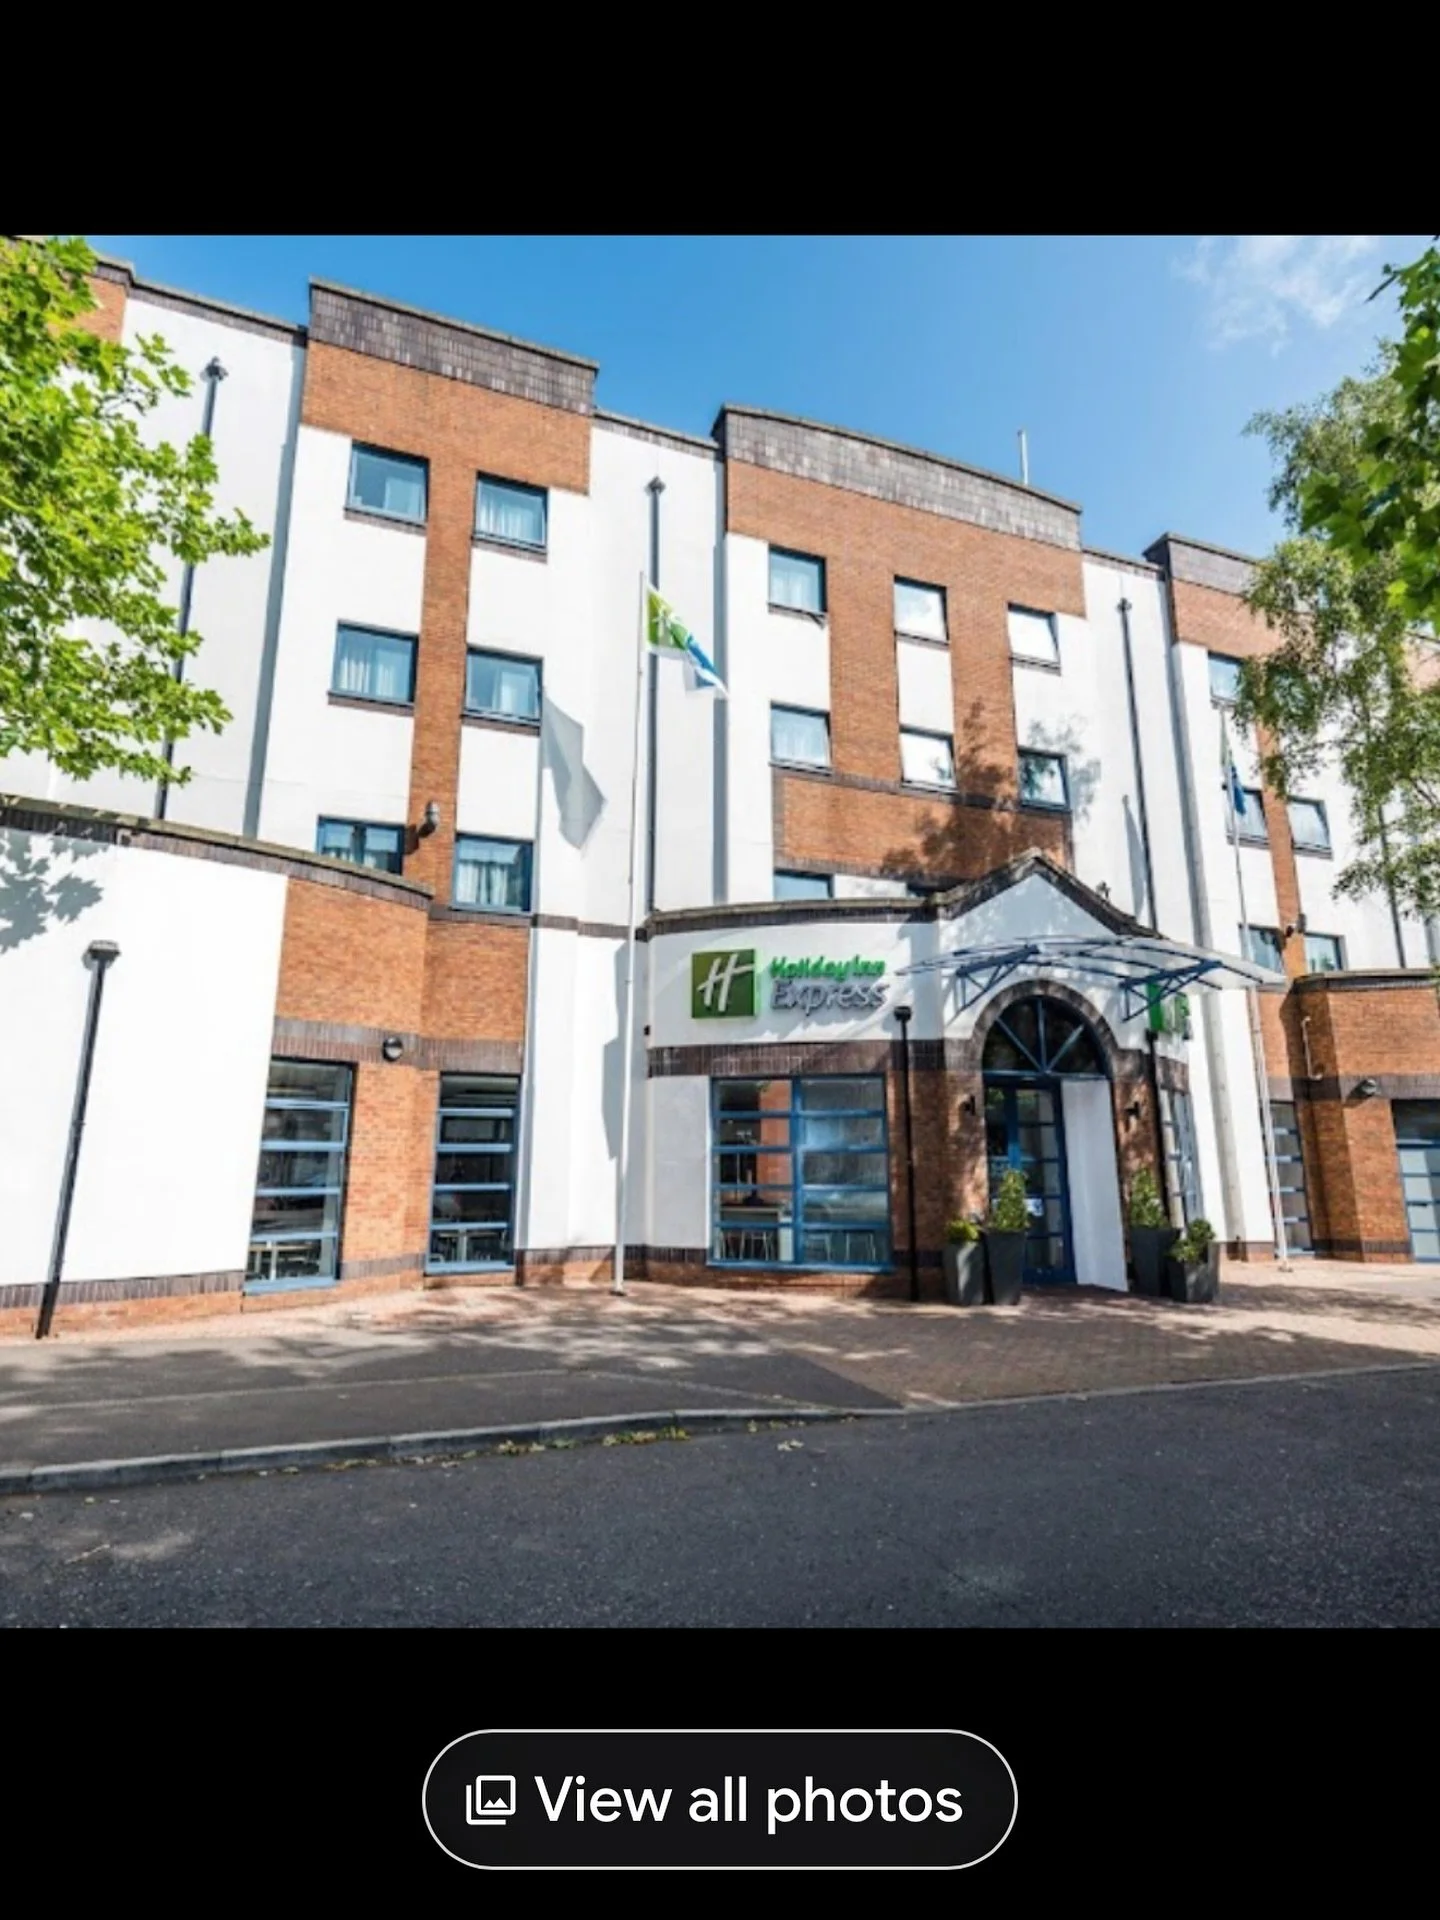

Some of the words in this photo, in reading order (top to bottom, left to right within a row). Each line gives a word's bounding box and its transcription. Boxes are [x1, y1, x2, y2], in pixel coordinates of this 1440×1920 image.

[769, 956, 848, 983] Holiday
[852, 954, 885, 976] Inn
[771, 980, 889, 1016] Express
